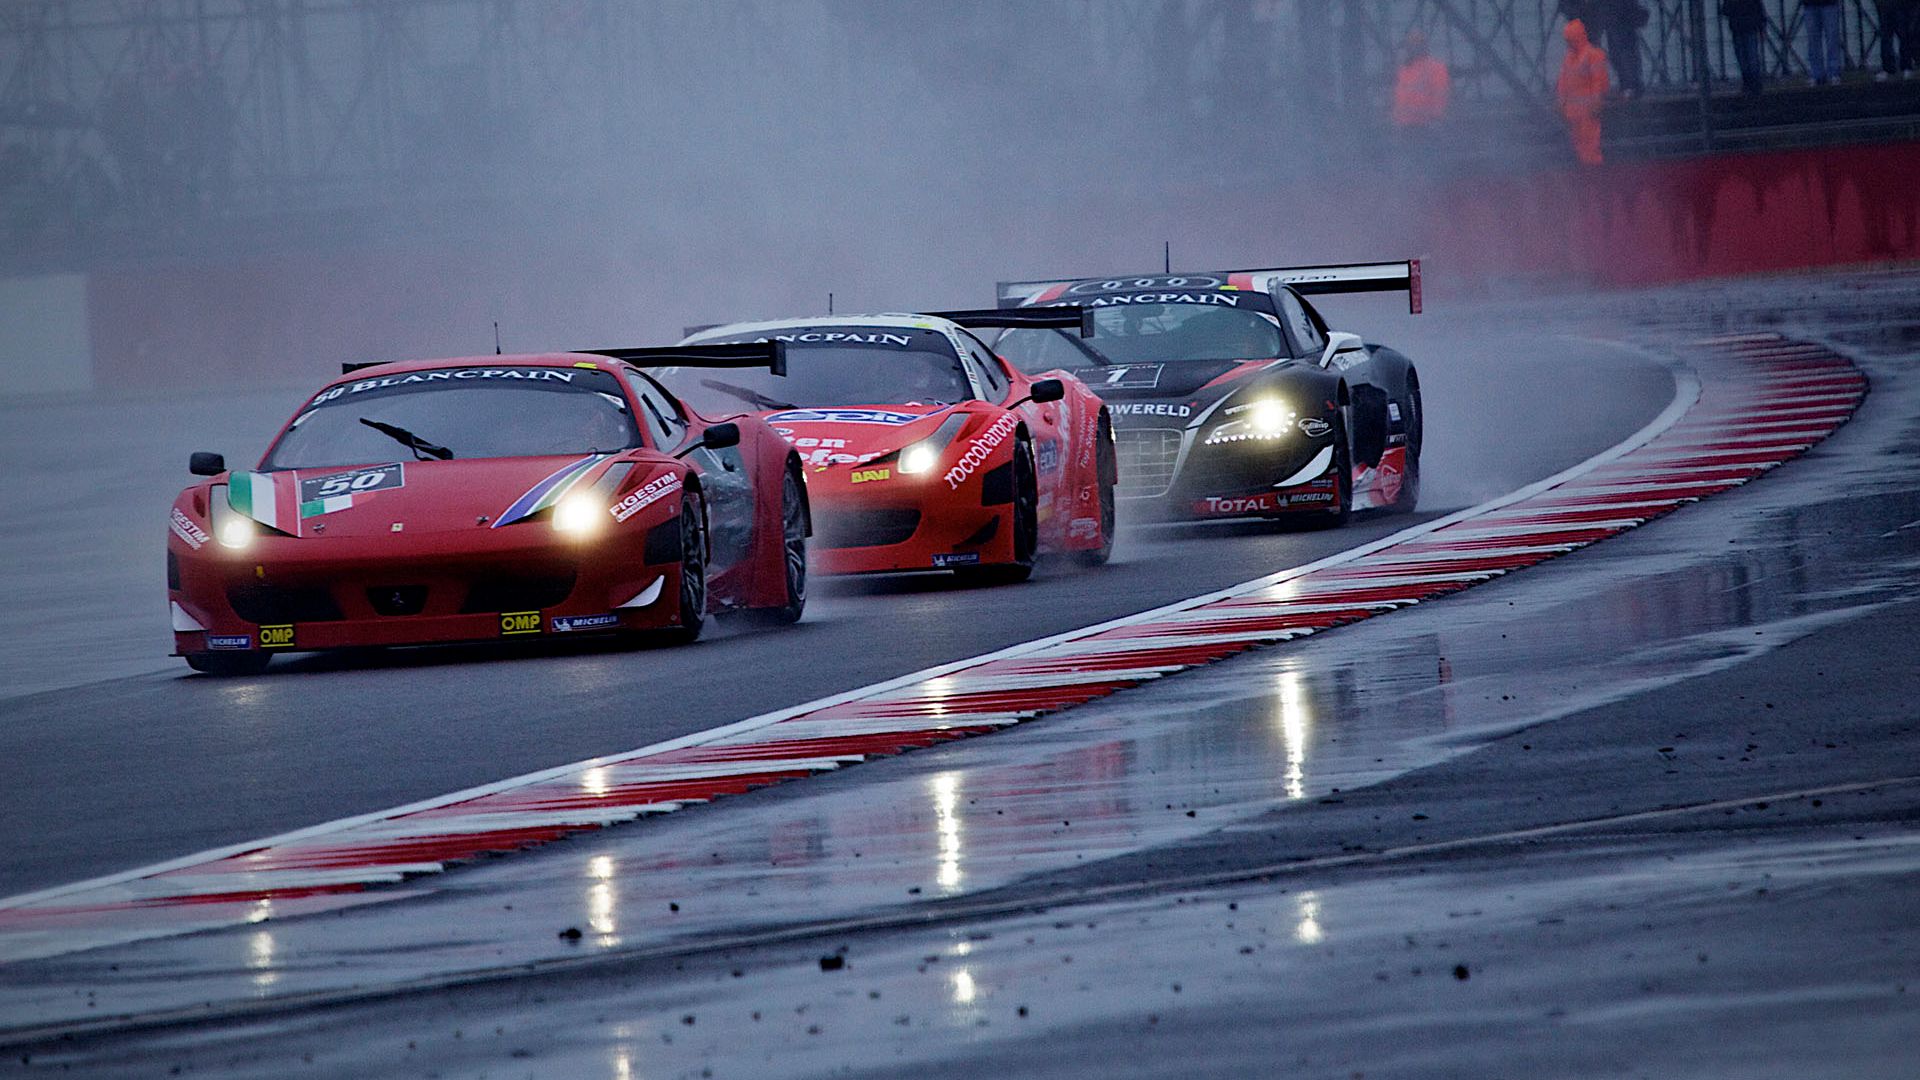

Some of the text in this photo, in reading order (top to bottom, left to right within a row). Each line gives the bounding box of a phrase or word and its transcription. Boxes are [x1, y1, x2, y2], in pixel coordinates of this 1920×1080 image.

[1107, 367, 1130, 383] 1
[312, 370, 576, 405] 50 BLANCPAIN
[318, 473, 386, 495] 50
[609, 472, 678, 516] FIGESTIM
[1290, 493, 1334, 503] MICHELIN
[1206, 496, 1271, 512] TOTAL
[501, 615, 540, 631] OMP
[573, 616, 617, 627] MICHELIN
[260, 628, 294, 644] OMP
